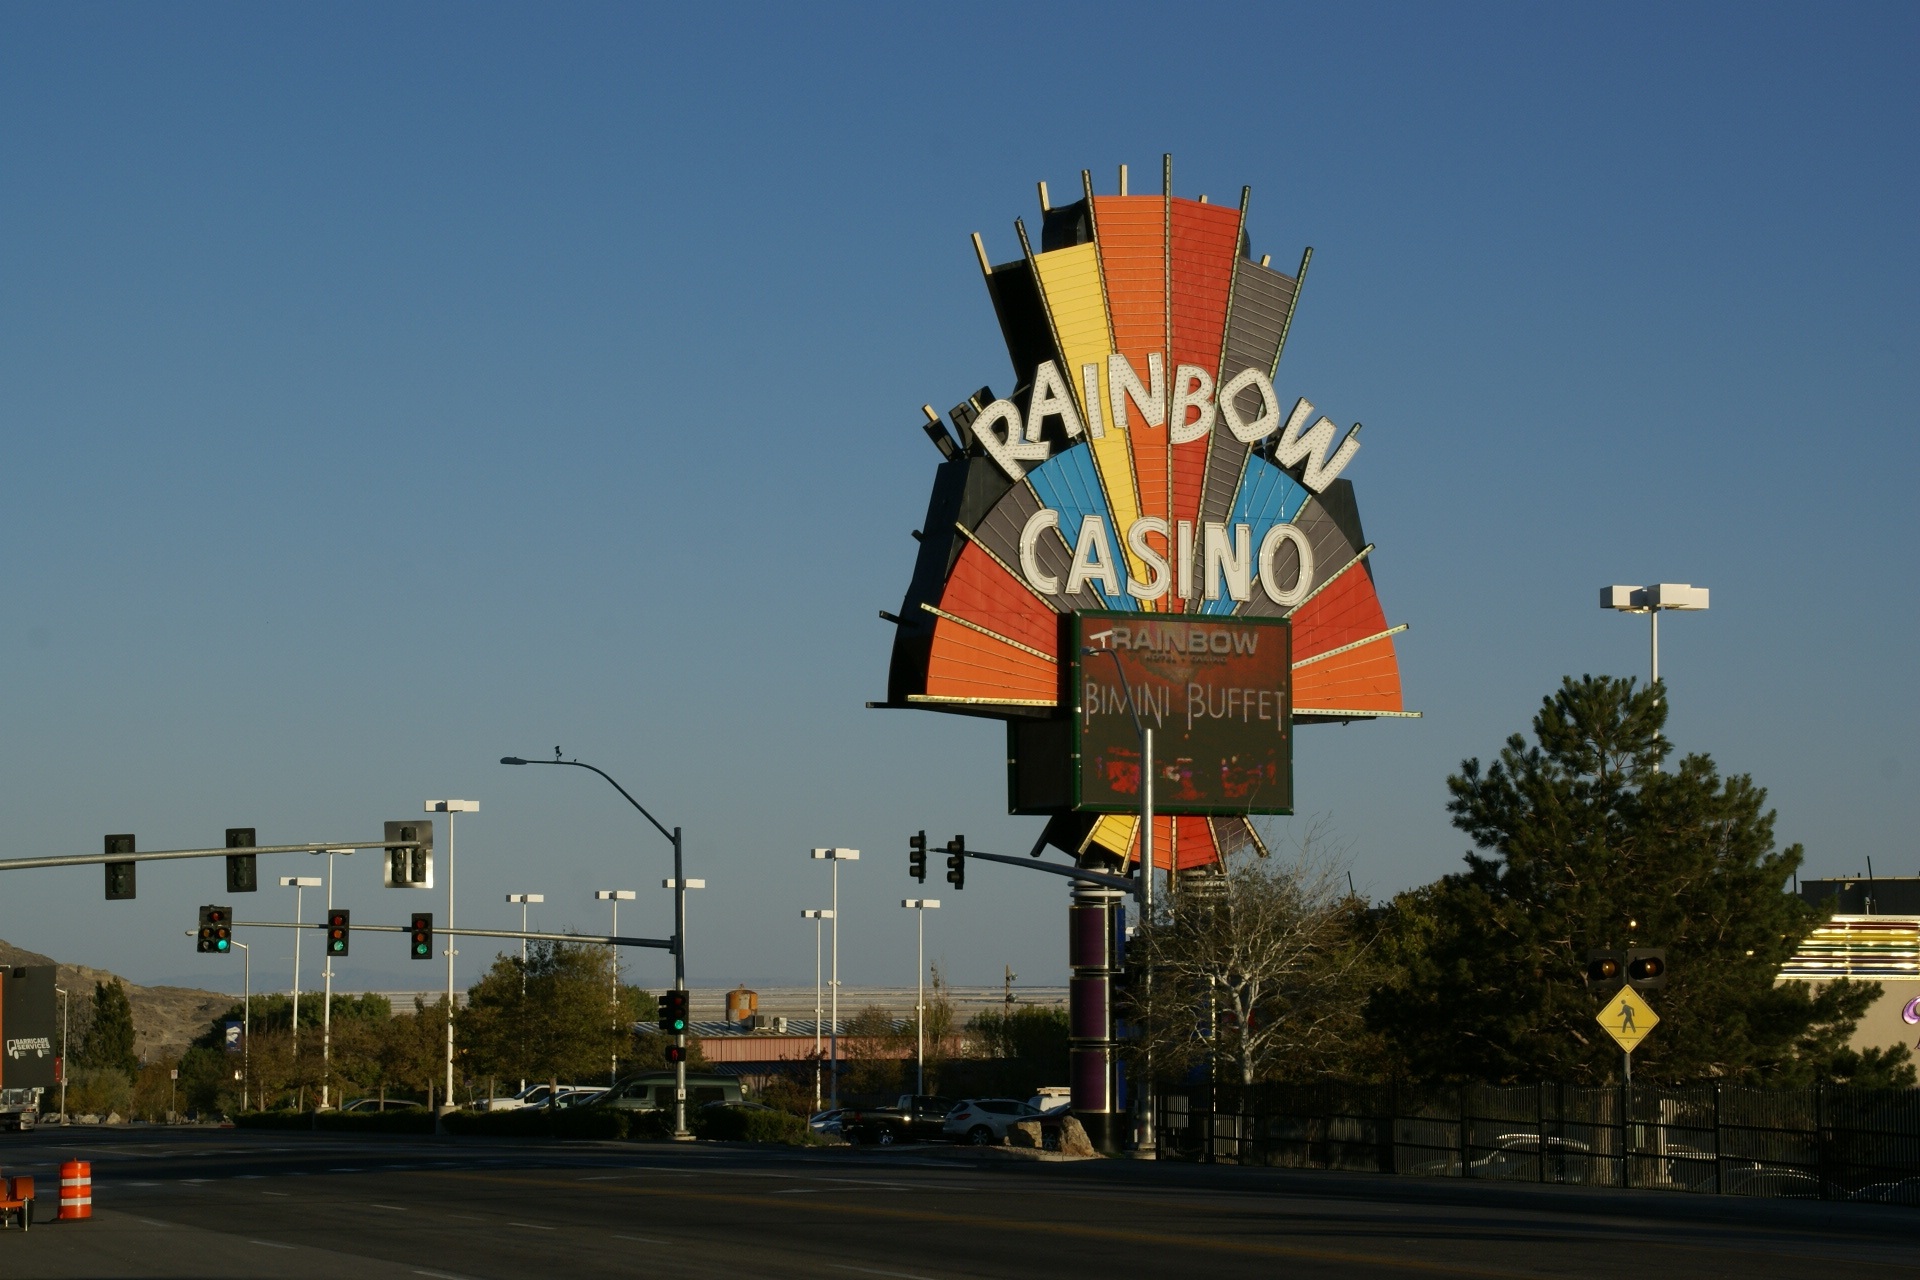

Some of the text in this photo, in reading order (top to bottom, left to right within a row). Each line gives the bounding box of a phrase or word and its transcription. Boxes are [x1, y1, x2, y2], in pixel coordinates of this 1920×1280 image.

[971, 352, 1361, 494] RAINBOW
[1019, 508, 1314, 606] CASINO
[1111, 627, 1259, 655] RAINBOW
[1085, 682, 1285, 731] BIMINI BUFFET
